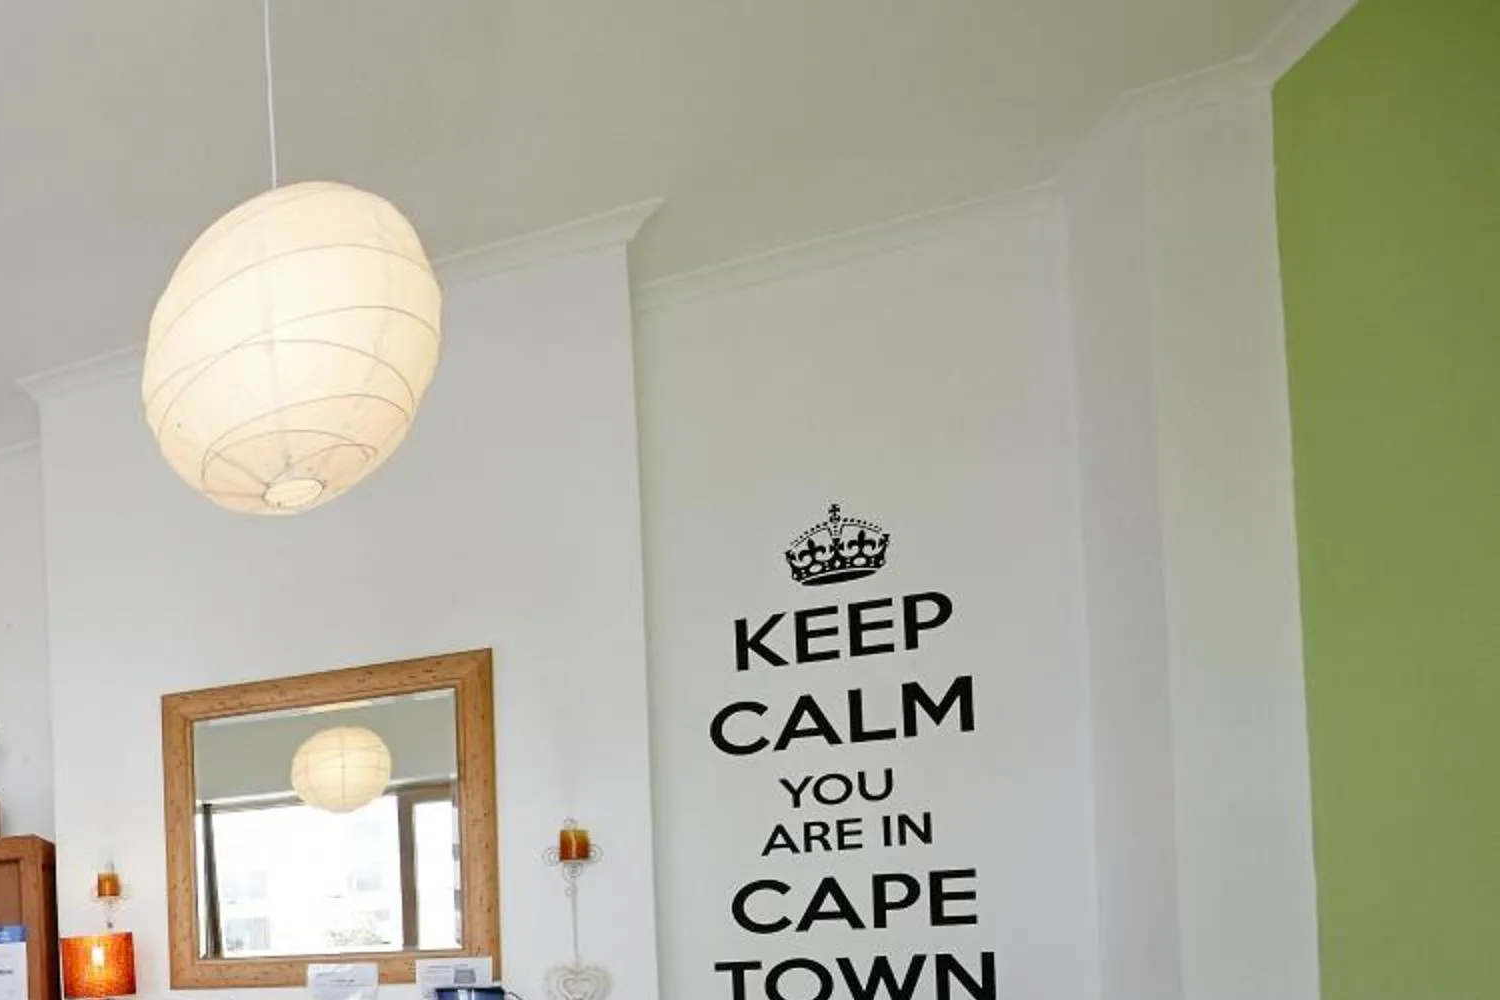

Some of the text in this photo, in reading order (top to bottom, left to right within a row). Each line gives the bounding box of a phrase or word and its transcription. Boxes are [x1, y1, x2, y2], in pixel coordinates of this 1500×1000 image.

[733, 590, 953, 673] KEEP
[709, 674, 975, 756] CALM
[778, 767, 893, 809] YOU
[761, 811, 933, 857] ARE IN
[730, 867, 978, 935] CAPE
